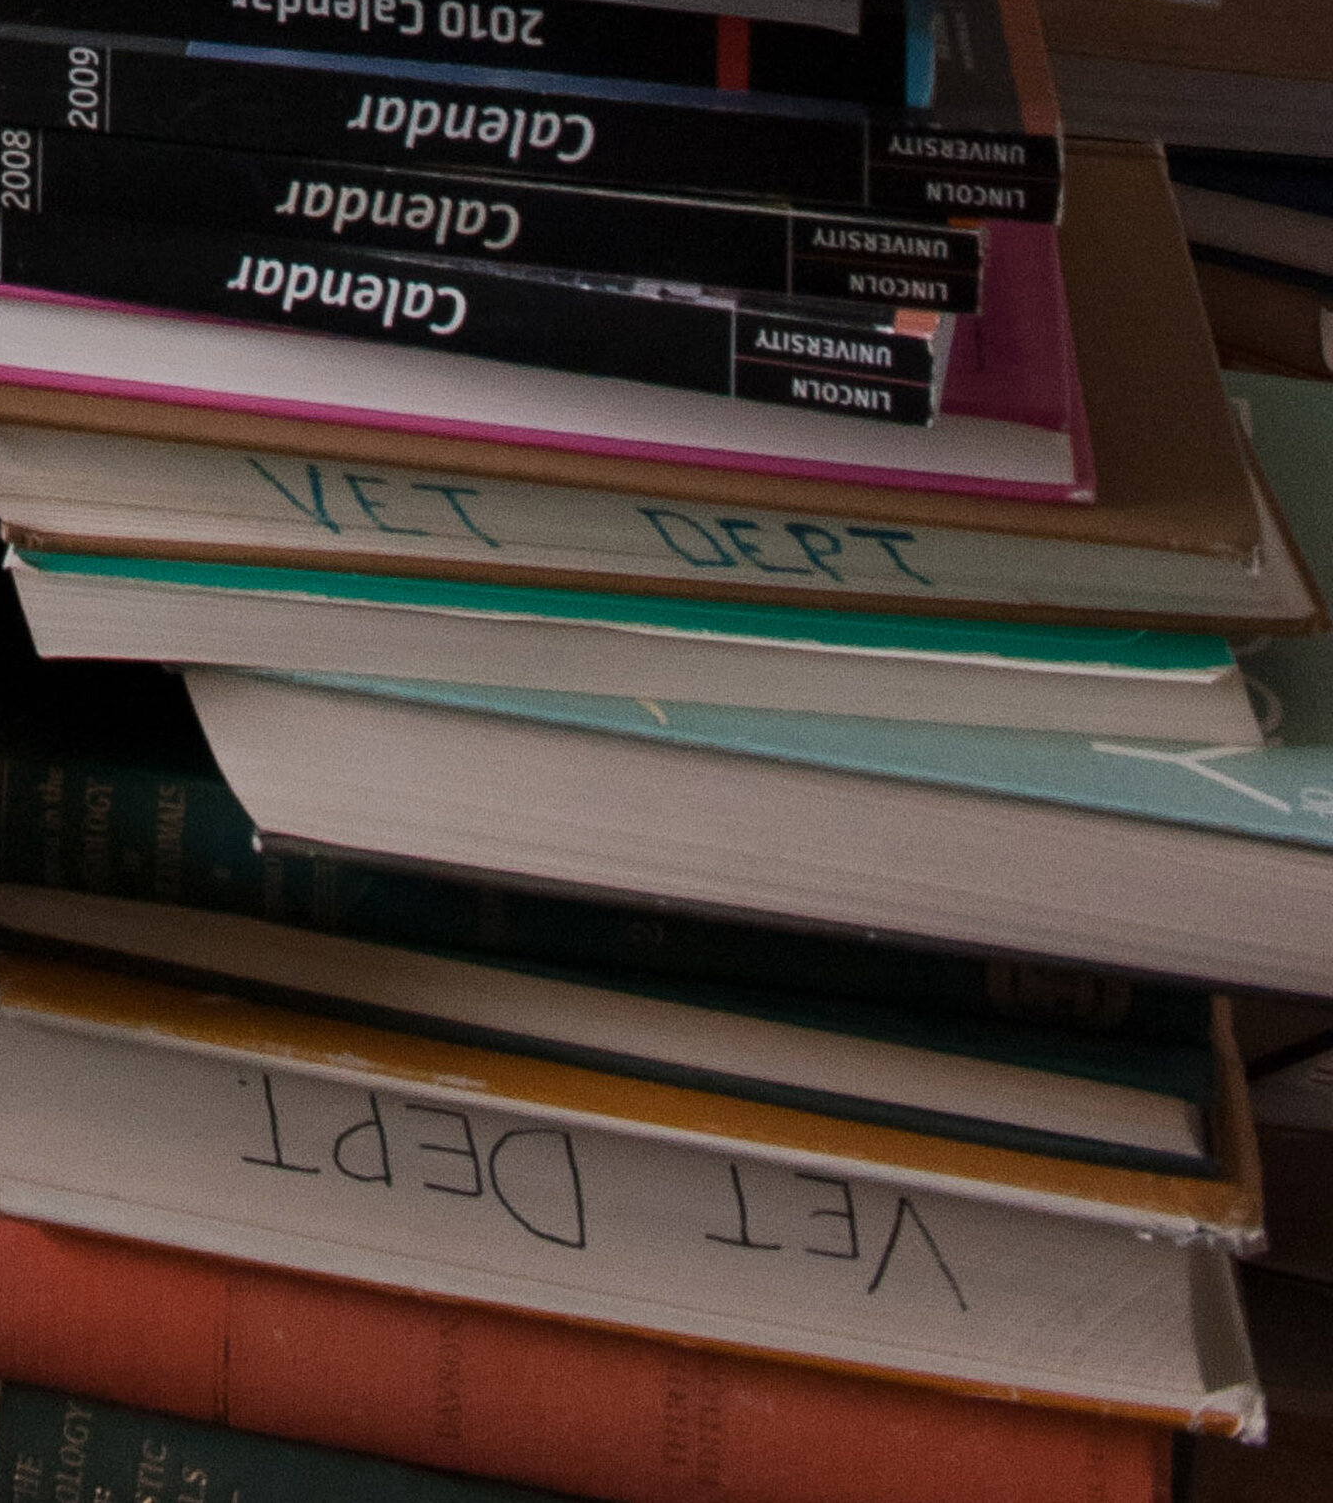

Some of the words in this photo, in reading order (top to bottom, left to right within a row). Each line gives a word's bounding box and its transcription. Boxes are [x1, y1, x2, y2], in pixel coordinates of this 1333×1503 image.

[68, 46, 100, 131] 2009
[346, 93, 596, 164] Calendar
[887, 131, 1026, 167] UNIVERSITY
[1, 128, 32, 212] 2008
[925, 179, 1027, 212] LINCOLN
[274, 178, 521, 251] Calendar
[811, 227, 949, 261] UNIVERSITY
[226, 252, 468, 335] Calendar
[848, 273, 950, 303] LINCOLN
[754, 328, 893, 368] UNIVERSITY
[791, 377, 893, 413] LINCOLN
[247, 457, 501, 548] VET
[635, 506, 932, 585] DEPT
[705, 1162, 968, 1312] VET
